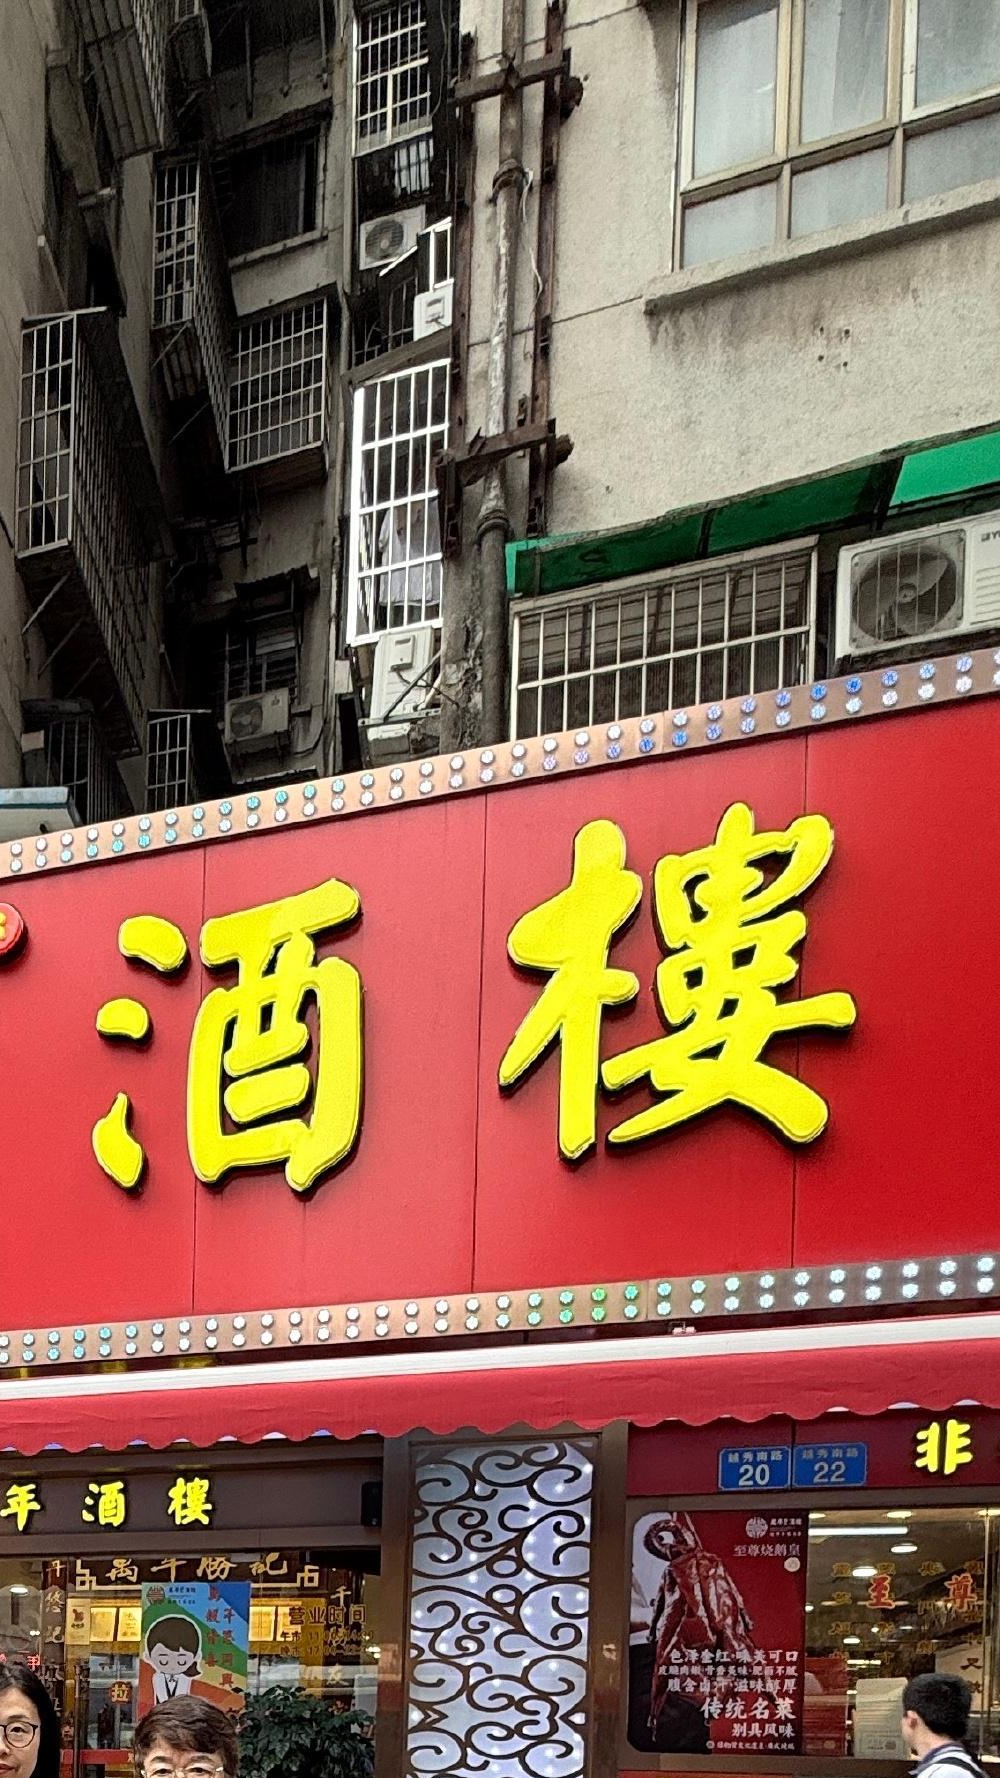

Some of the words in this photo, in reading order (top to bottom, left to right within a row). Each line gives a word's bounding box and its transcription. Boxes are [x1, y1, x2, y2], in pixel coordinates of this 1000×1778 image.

[914, 1419, 973, 1475] 非
[738, 1464, 770, 1486] 20
[813, 1460, 846, 1483] 22
[288, 1605, 367, 1626] 营业时间
[700, 1696, 797, 1720] 传统名菜
[732, 1722, 796, 1738] 别具风味
